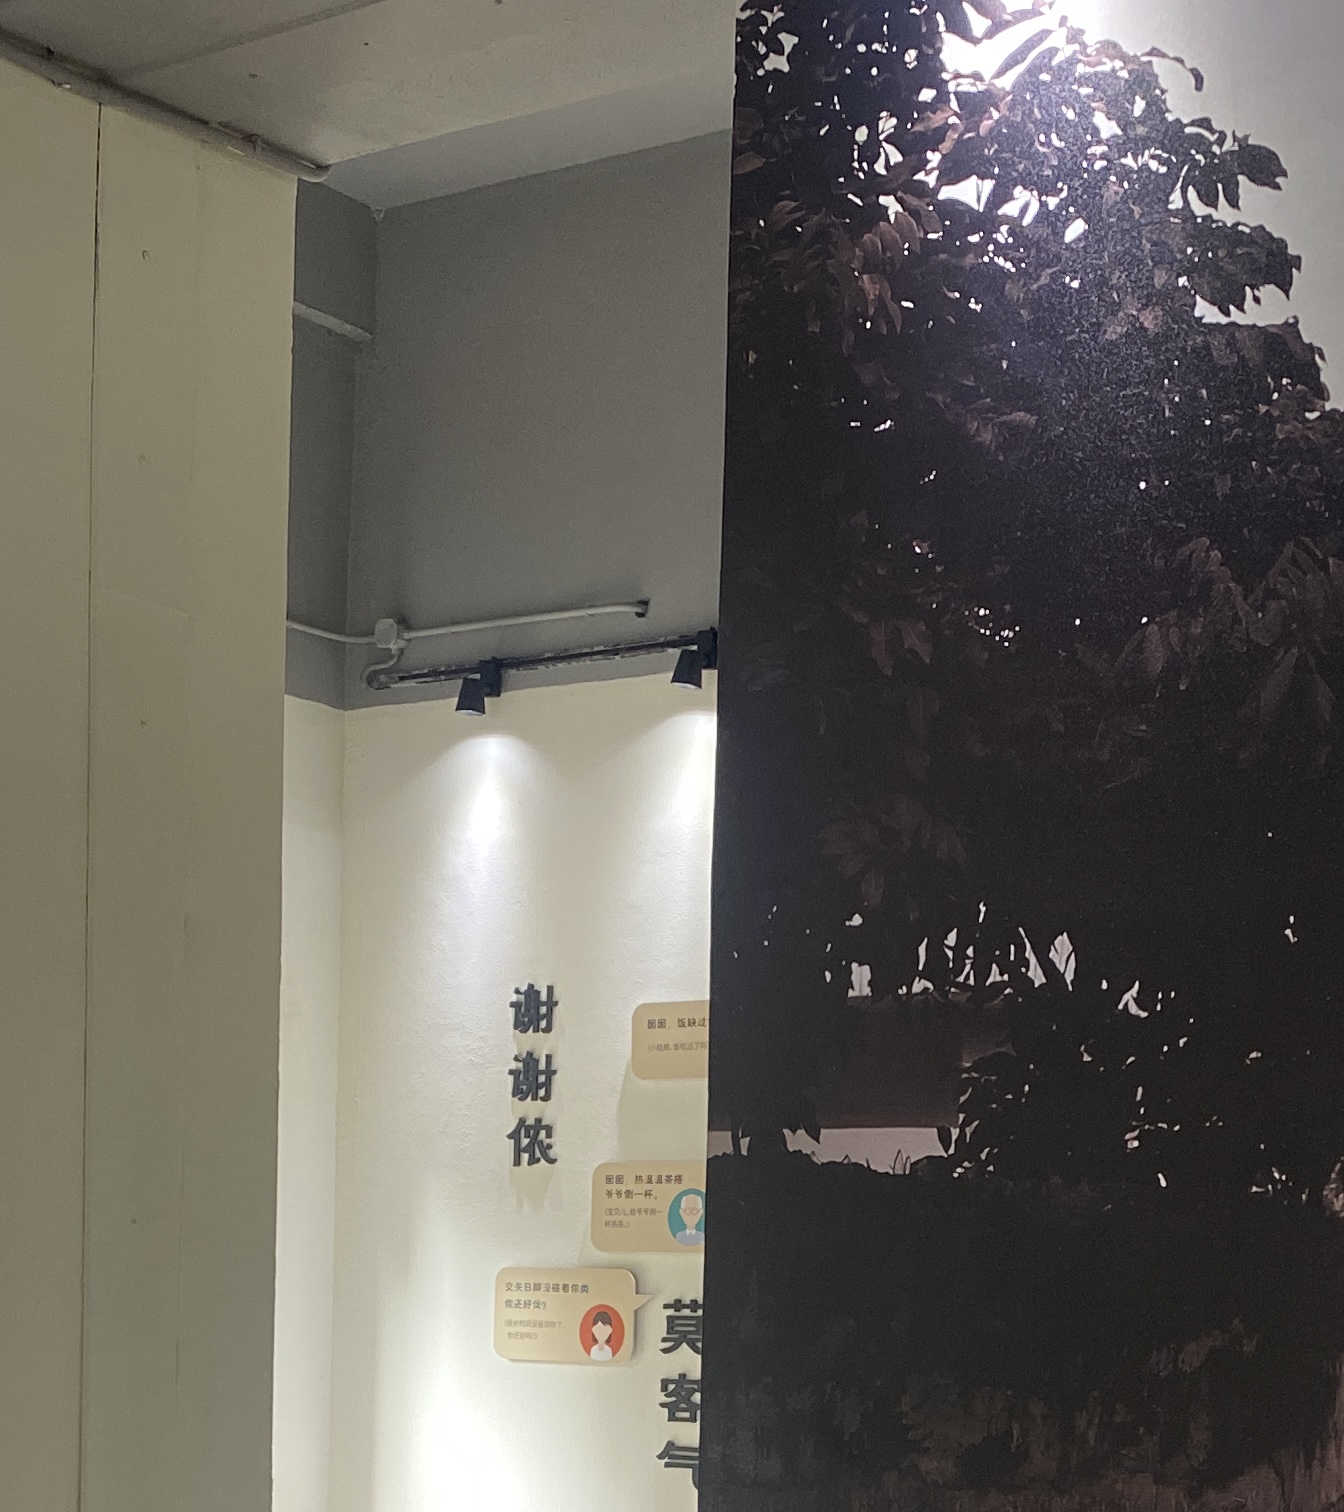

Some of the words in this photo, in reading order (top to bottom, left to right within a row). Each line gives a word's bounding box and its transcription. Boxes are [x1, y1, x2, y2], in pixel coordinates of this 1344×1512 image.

[506, 983, 559, 1166] 谢谢侬
[656, 1299, 704, 1490] 莫客气
